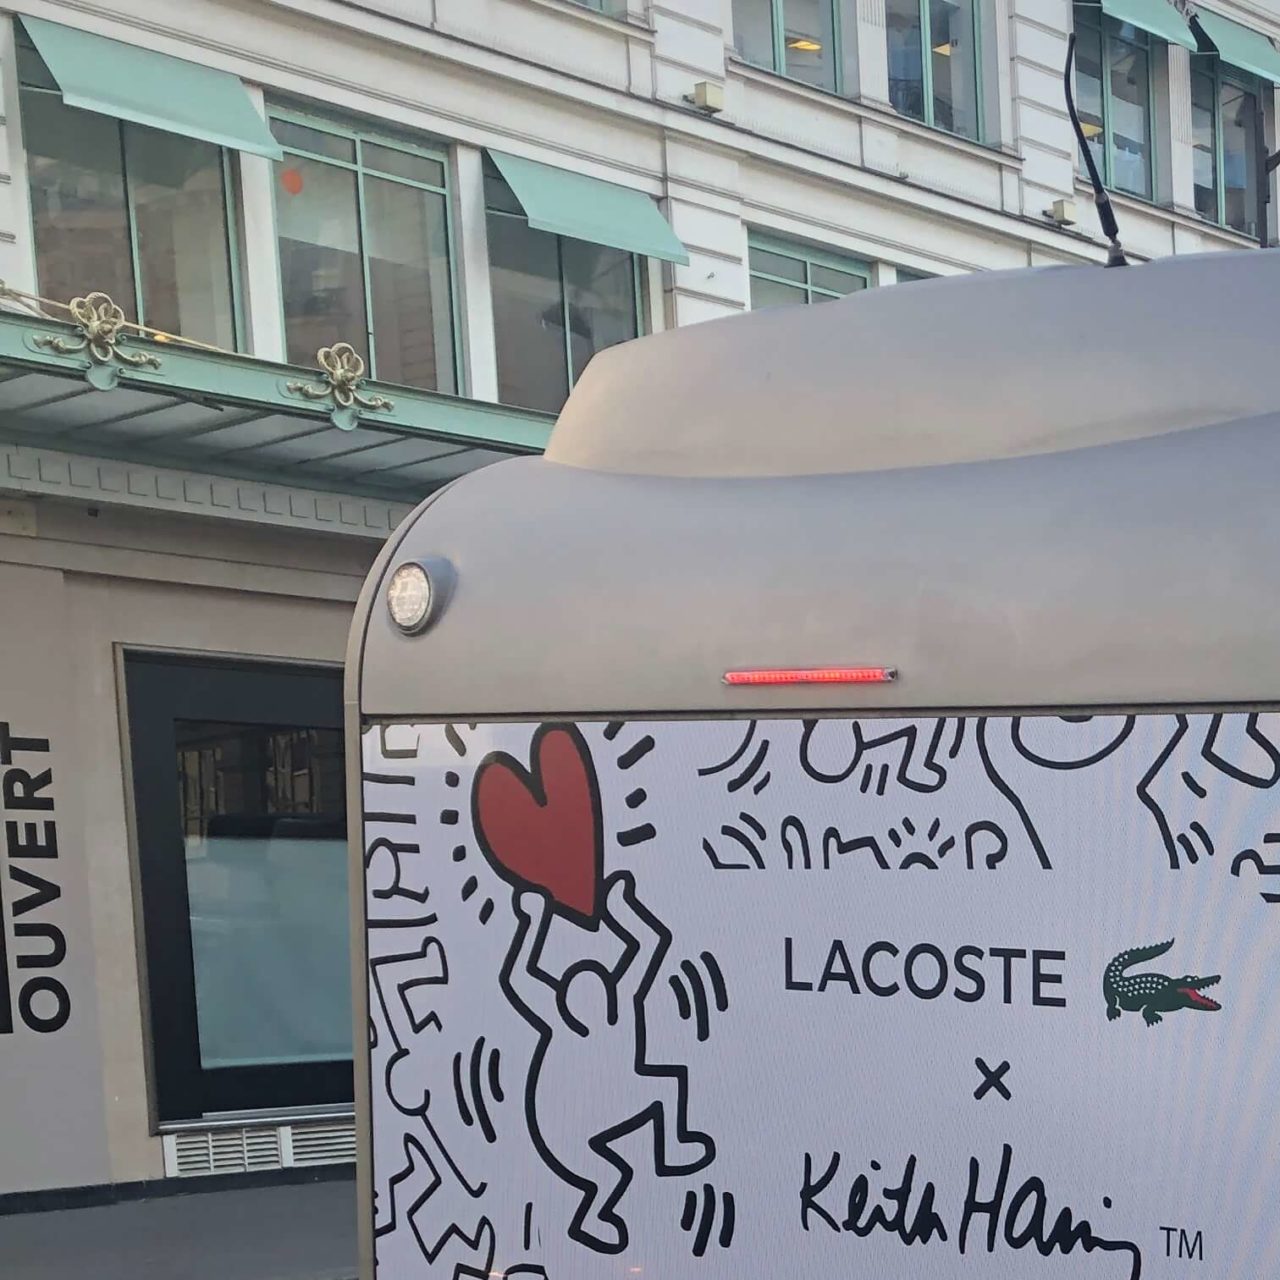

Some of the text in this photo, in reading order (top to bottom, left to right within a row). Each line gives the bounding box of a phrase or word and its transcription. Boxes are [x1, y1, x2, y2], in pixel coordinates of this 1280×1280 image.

[0, 721, 71, 1034] OUVERT
[784, 937, 1066, 1007] LACOSTE
[800, 1152, 947, 1245] Keith
[1159, 1226, 1203, 1260] TM
